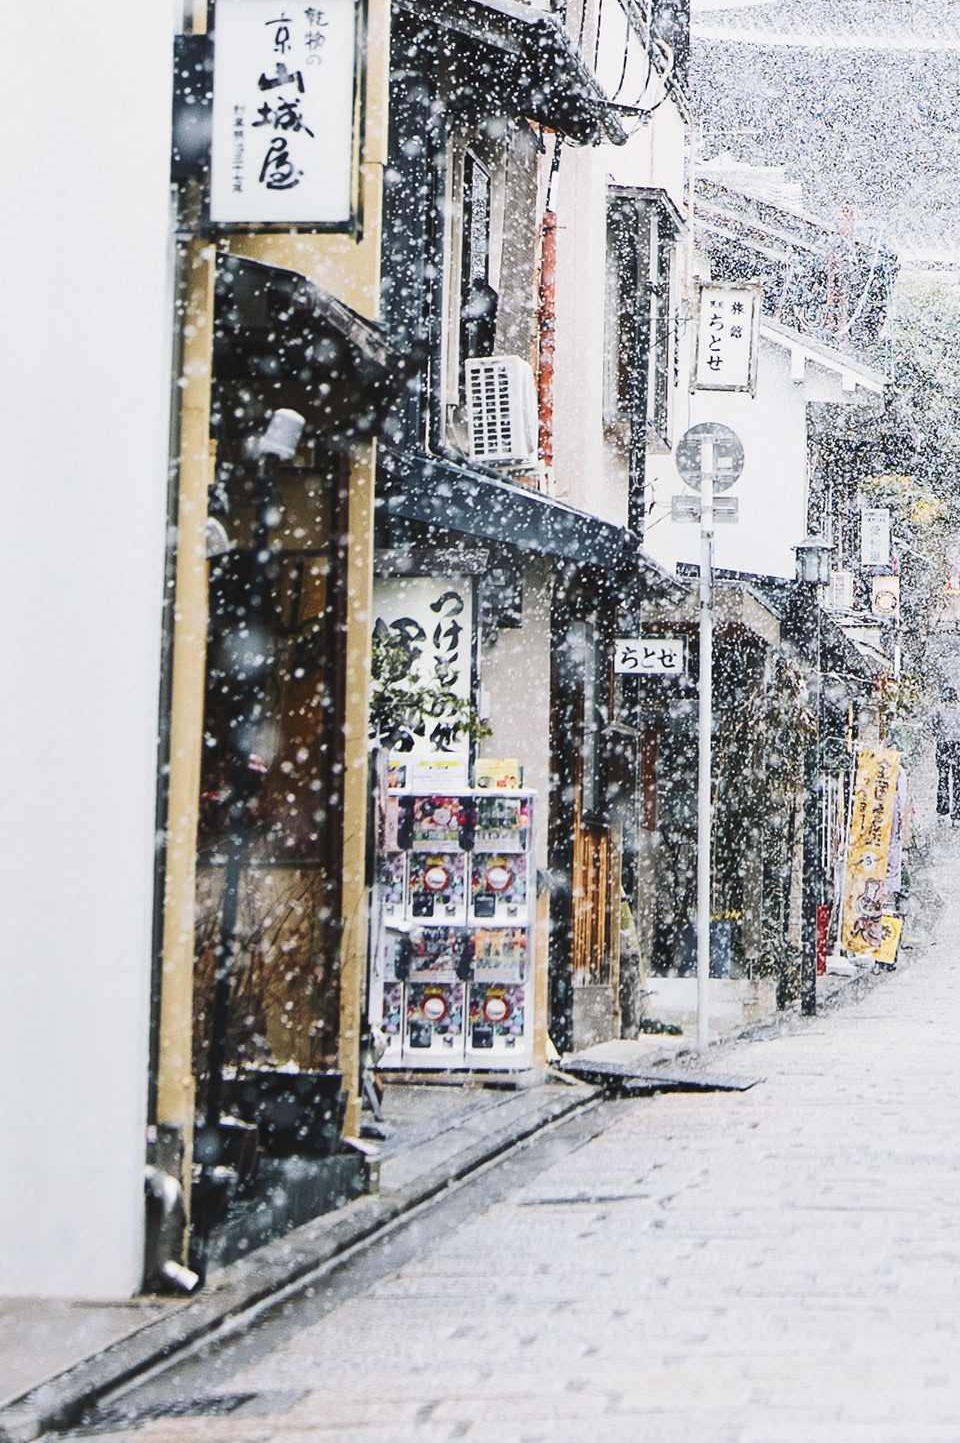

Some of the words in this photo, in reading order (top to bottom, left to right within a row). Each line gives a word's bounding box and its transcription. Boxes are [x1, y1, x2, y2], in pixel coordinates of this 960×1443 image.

[251, 12, 315, 191] 京山城屋
[706, 313, 724, 371] ちとせ
[621, 646, 678, 669] ちとせ
